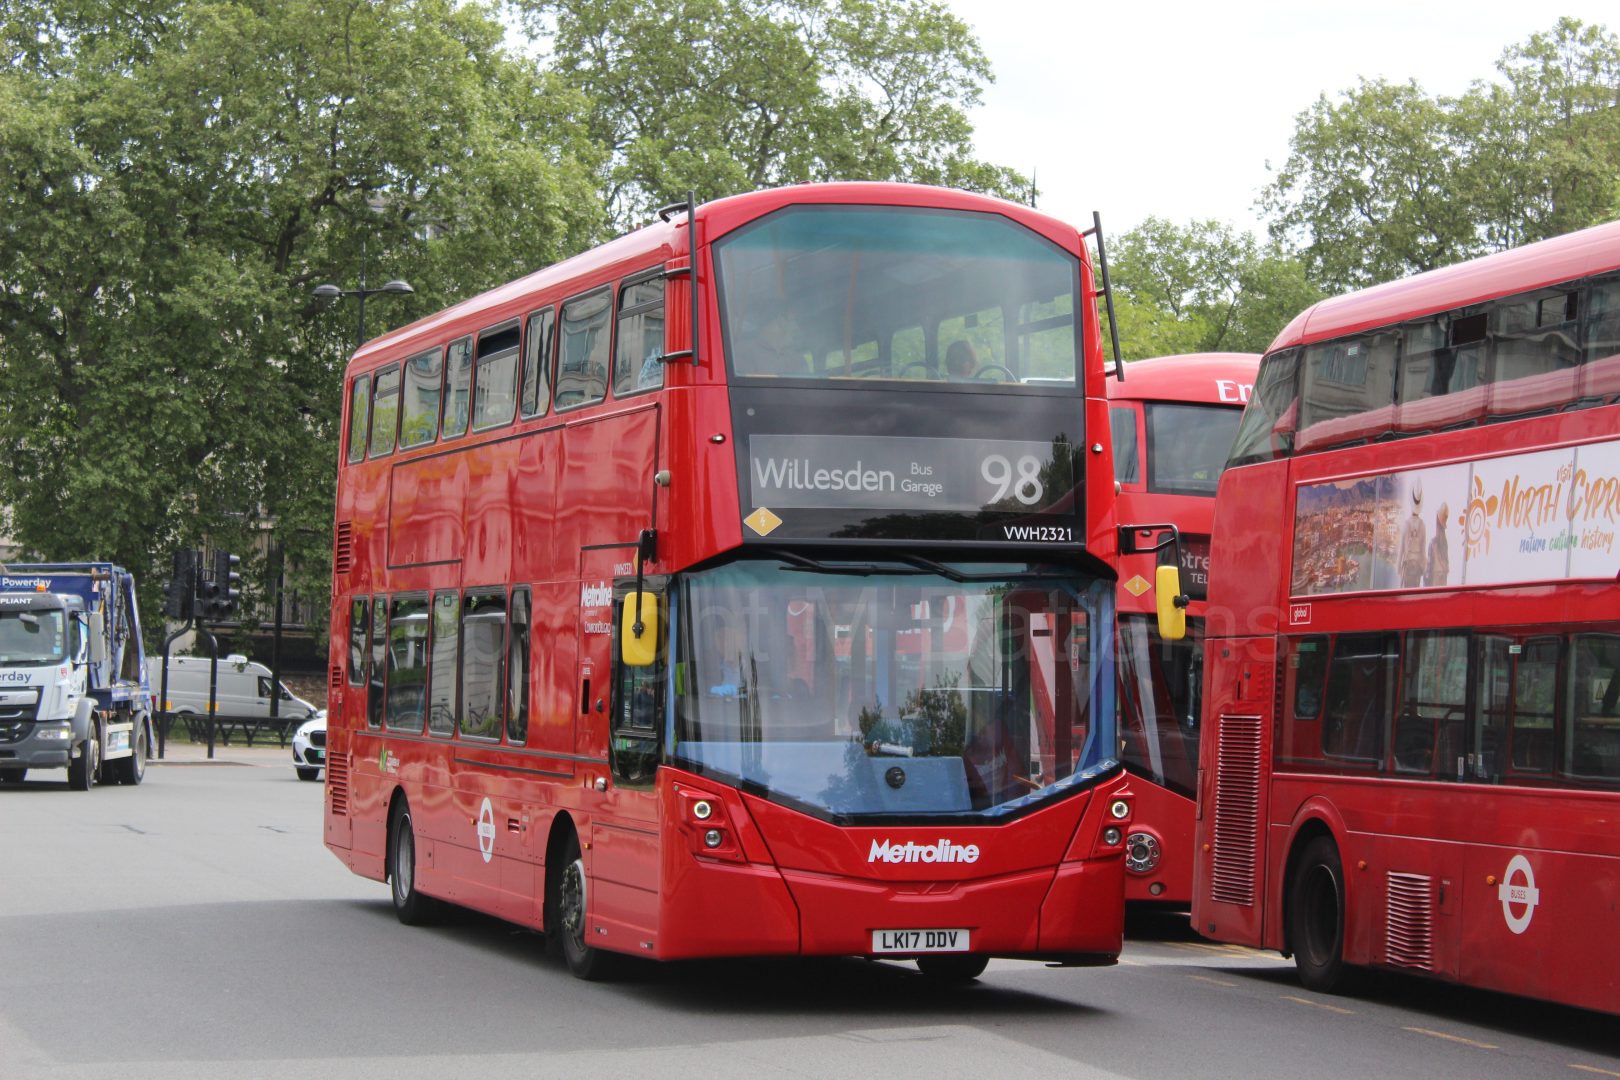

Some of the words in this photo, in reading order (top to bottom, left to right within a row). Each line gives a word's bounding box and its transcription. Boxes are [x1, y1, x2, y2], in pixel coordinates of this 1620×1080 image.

[754, 457, 895, 492] Willesden
[911, 463, 932, 475] Bus
[980, 454, 1044, 506] 98
[901, 480, 943, 497] Garage
[1497, 474, 1562, 534] NORTH
[1004, 526, 1073, 541] VWH2321
[1580, 525, 1614, 554] history
[2, 577, 51, 588] Powerday
[581, 581, 612, 607] Metroline
[868, 838, 980, 864] Metroline
[1510, 889, 1526, 900] BUSES
[882, 931, 919, 950] LK17
[925, 930, 957, 948] DDV
